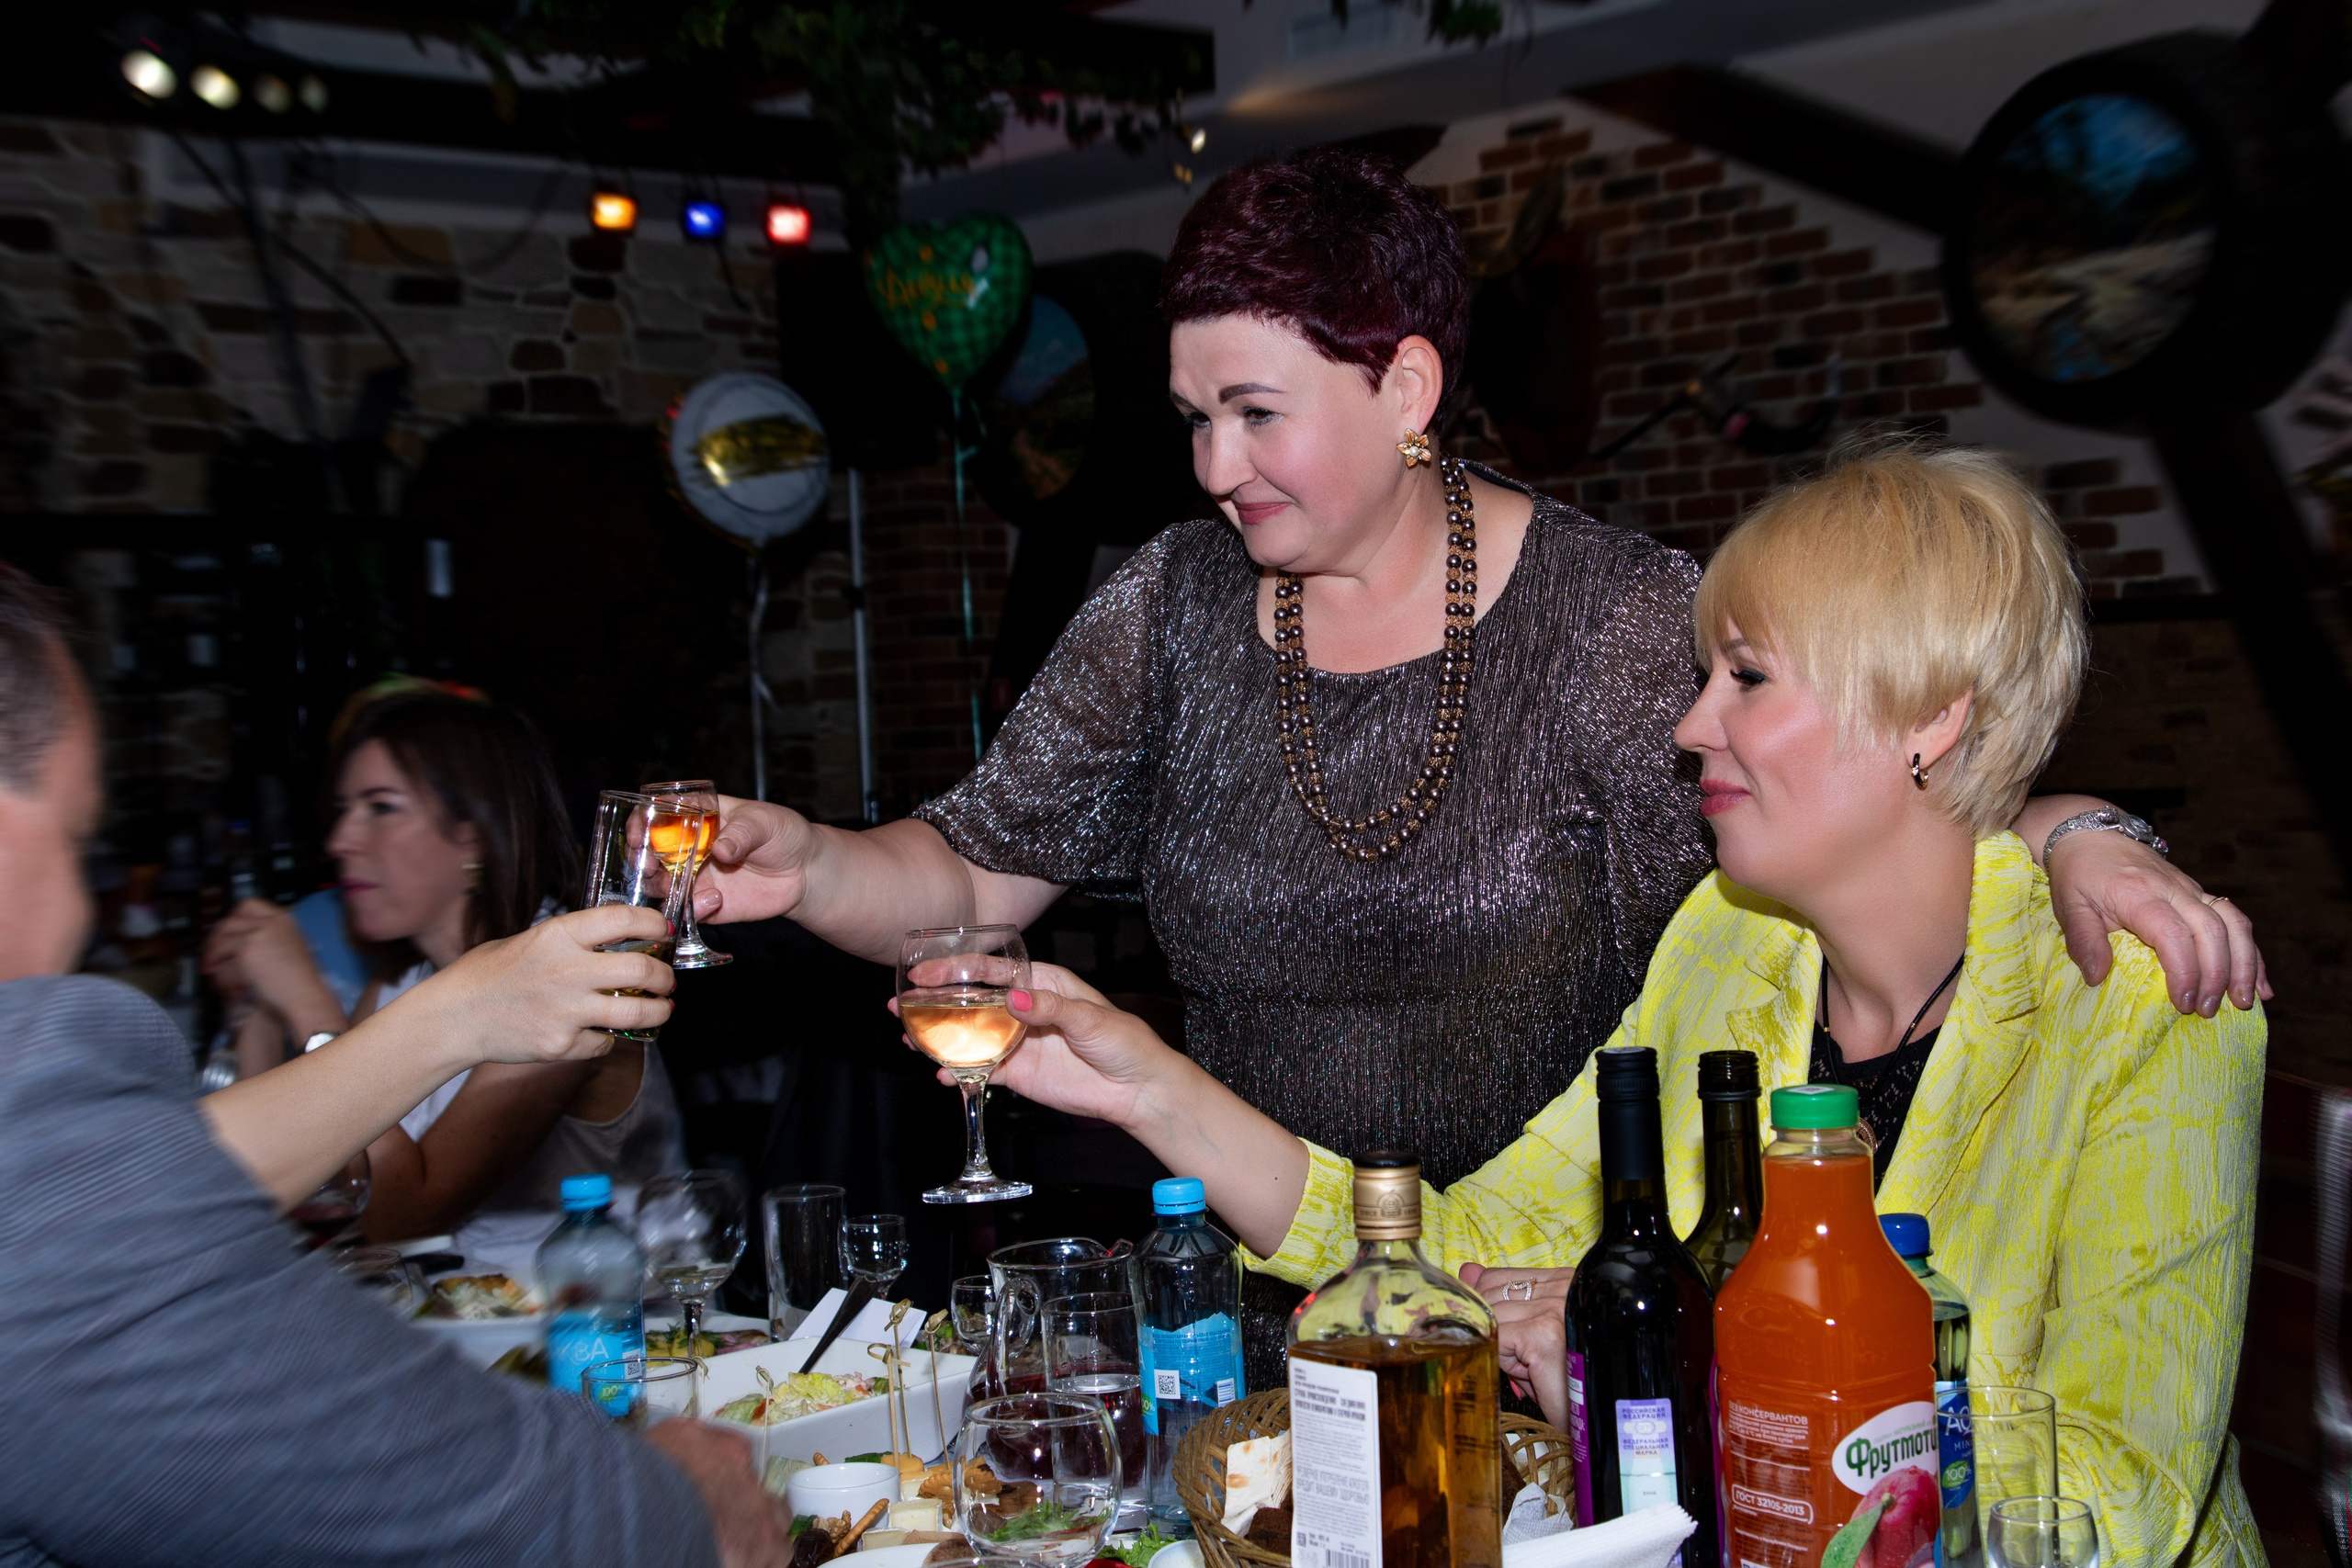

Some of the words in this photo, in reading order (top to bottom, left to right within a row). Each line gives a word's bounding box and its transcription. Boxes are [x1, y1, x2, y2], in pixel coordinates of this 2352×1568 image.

[1738, 1405, 1808, 1425] КОНСЕРВАНТОВ
[1947, 1464, 1973, 1481] 100%
[1736, 1490, 1756, 1505] ГОСТ
[1757, 1496, 1805, 1516] 32105-2013
